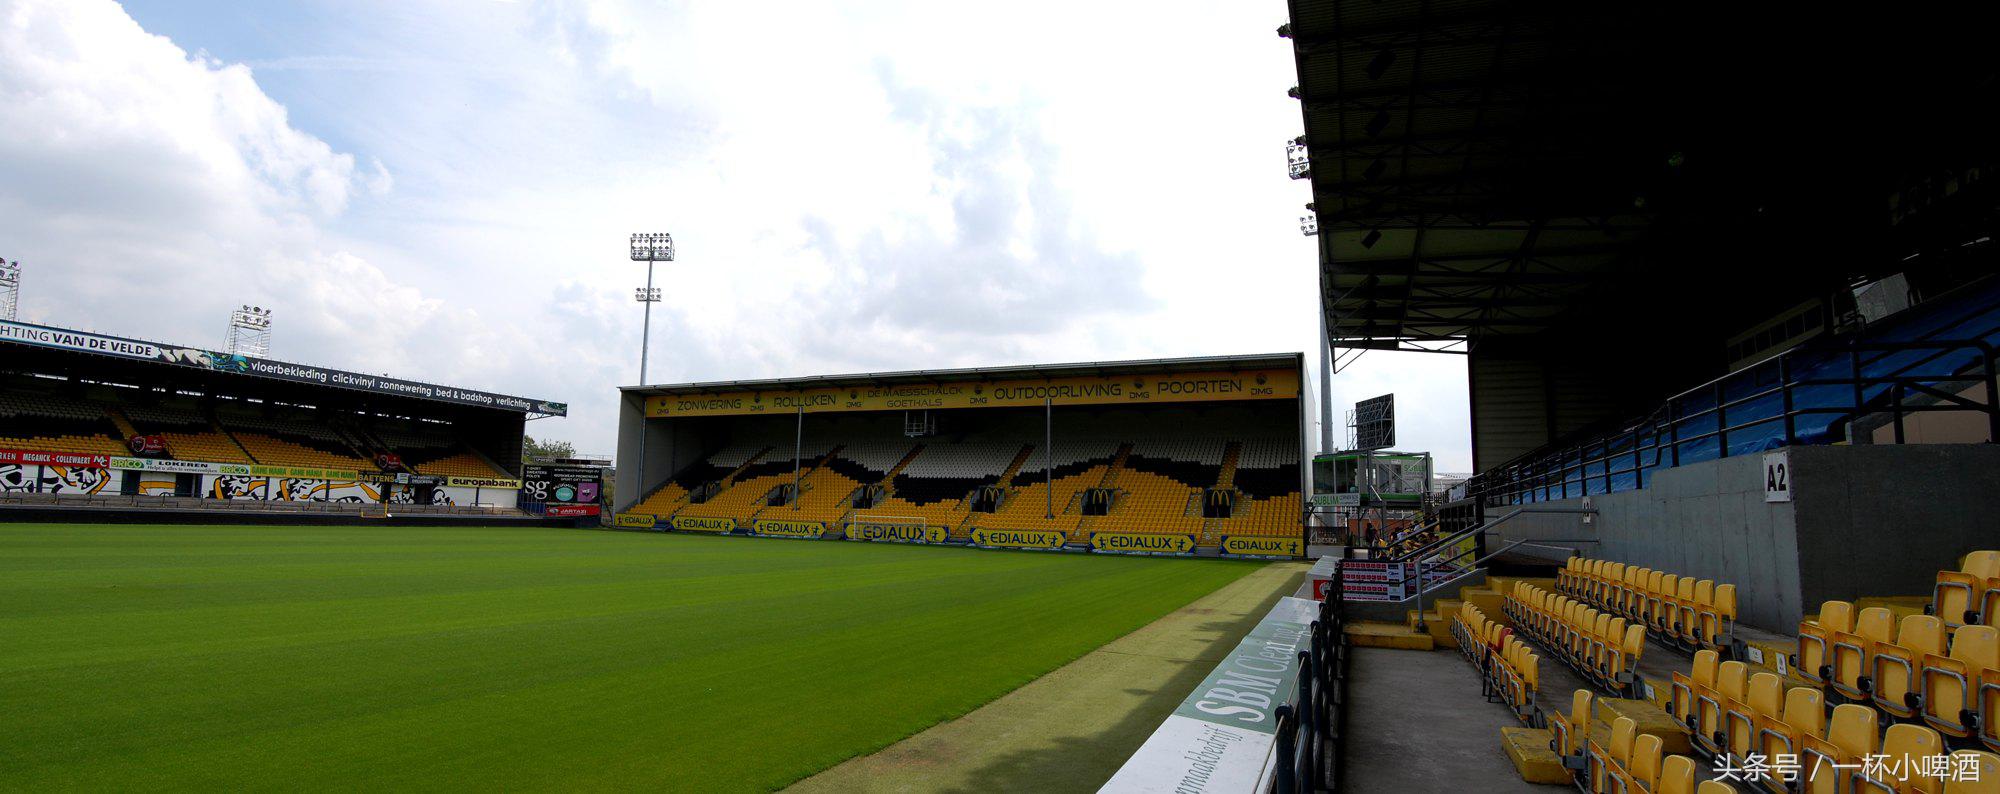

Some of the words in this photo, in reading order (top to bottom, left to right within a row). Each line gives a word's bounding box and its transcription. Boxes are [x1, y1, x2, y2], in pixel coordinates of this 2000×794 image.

[53, 333, 84, 346] VAN
[89, 339, 107, 350] DE
[111, 341, 152, 356] VELDE
[251, 360, 327, 383] vloerbekleding
[332, 372, 375, 388] clickvinyl
[379, 380, 432, 396] zonnewering
[436, 387, 451, 398] bed
[453, 390, 459, 399] &
[460, 391, 493, 404] badshop
[495, 396, 531, 411] verlichting
[993, 383, 1122, 400] OUTDOORLIVING
[1157, 380, 1242, 395] POORTEN
[1250, 388, 1274, 396] DMG
[867, 389, 881, 398] DE
[1129, 391, 1150, 399] DMG
[677, 398, 742, 412] ZONWERING
[887, 398, 943, 408] GOETHALS
[969, 397, 988, 405] DMG
[452, 479, 518, 488] europabank
[1767, 463, 1787, 491] A2
[525, 480, 550, 500] sg
[1314, 496, 1340, 505] SUBLIM
[683, 519, 722, 529] EDIALUX
[766, 523, 810, 534] EDIALUX
[863, 526, 925, 540] EDIALUX
[990, 532, 1046, 545] EDIALUX
[1110, 536, 1172, 549] EDIALUX
[1229, 540, 1282, 551] EDIALUX
[1195, 670, 1282, 723] SBM
